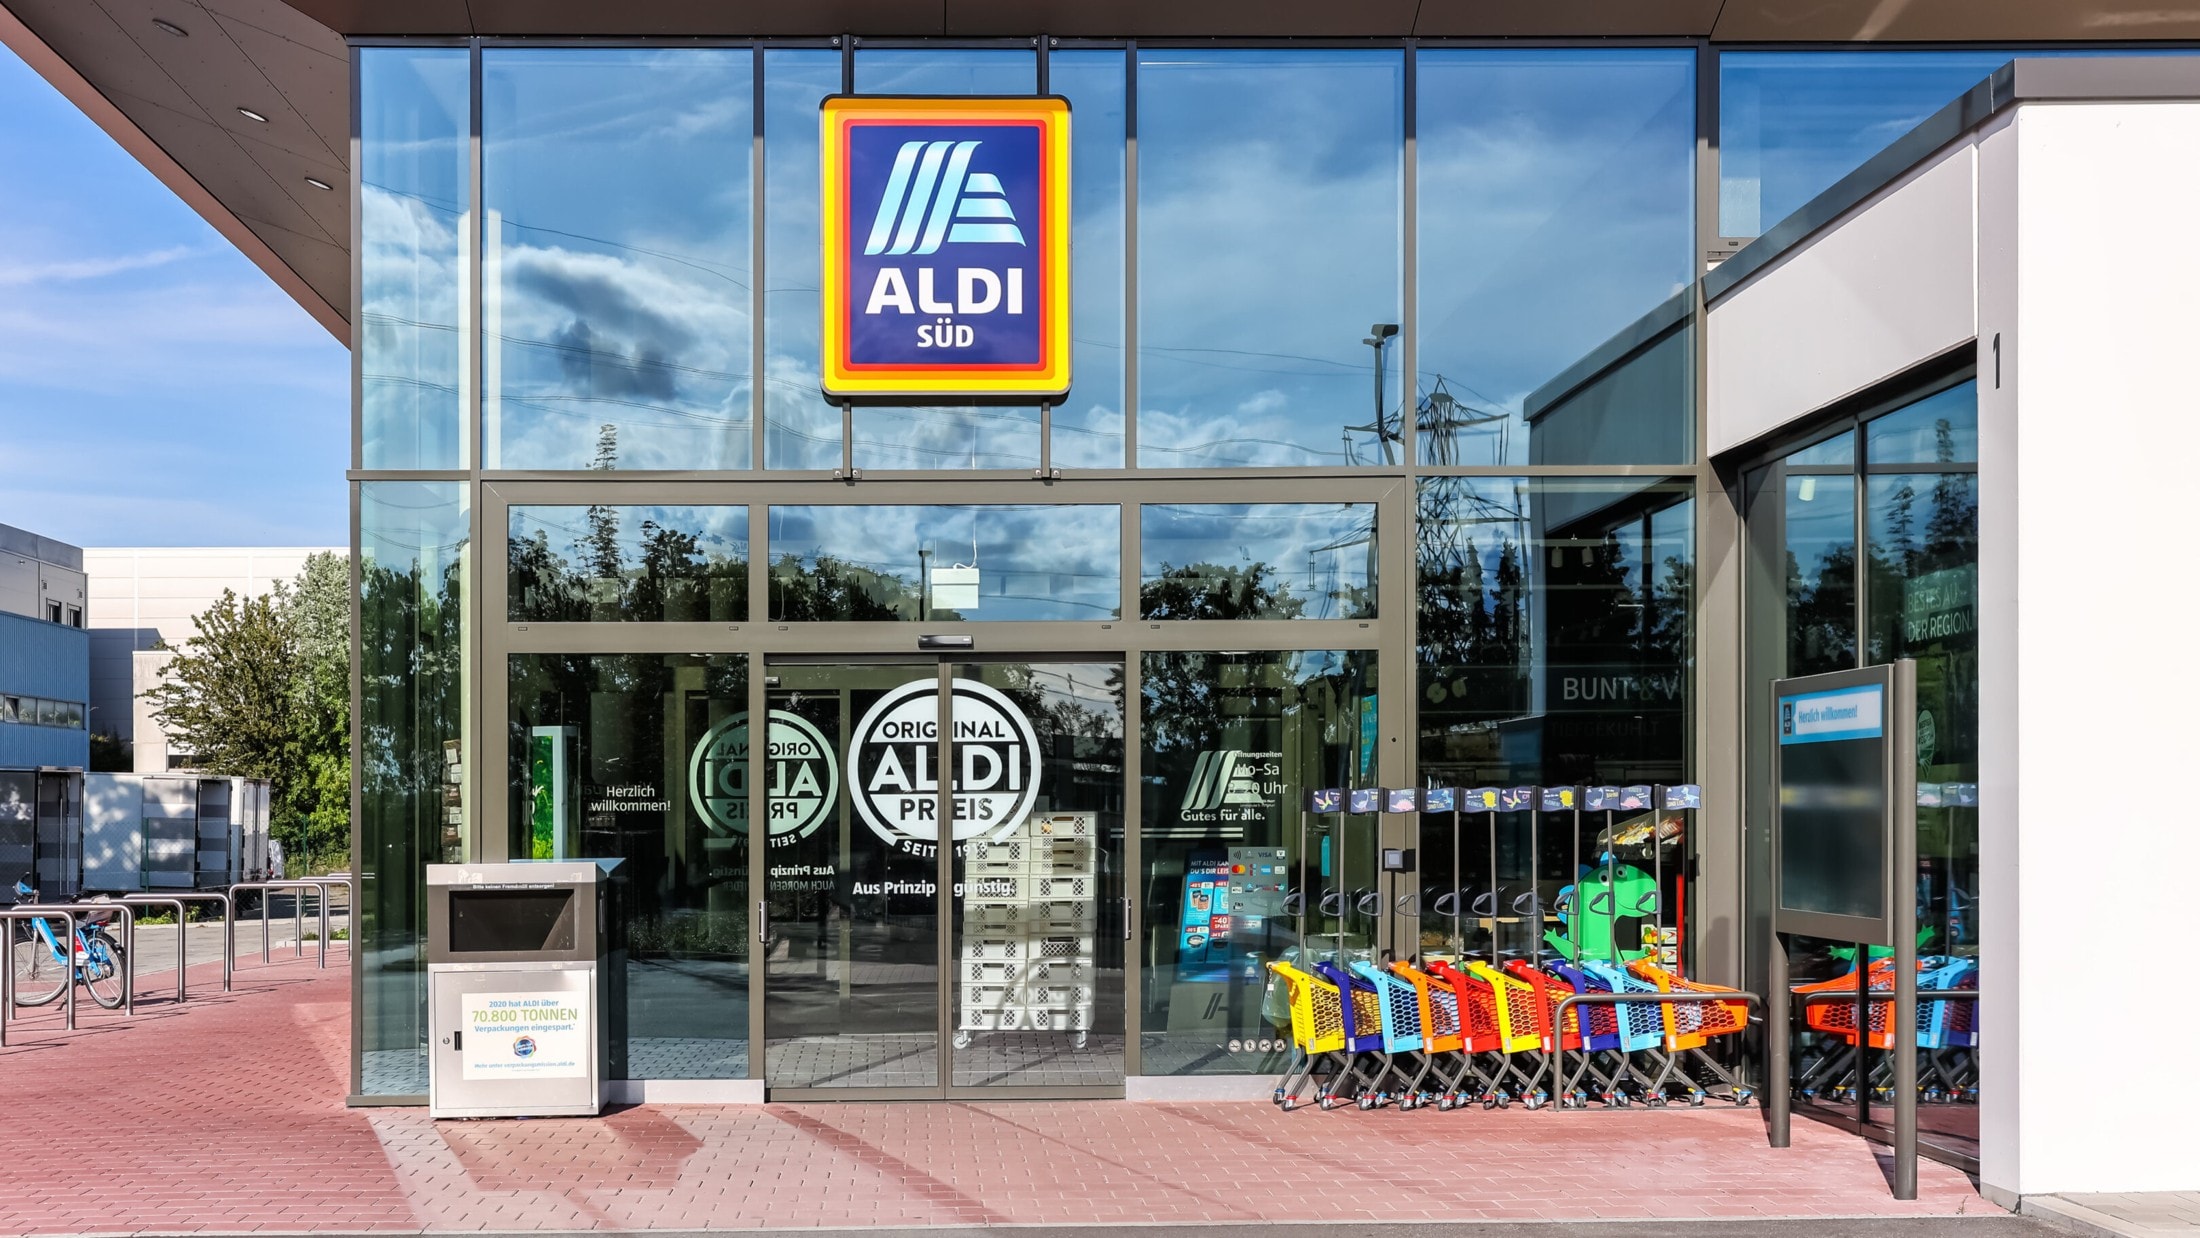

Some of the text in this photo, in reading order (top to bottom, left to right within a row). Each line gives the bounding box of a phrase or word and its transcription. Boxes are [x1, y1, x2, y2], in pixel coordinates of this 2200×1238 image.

[865, 267, 1023, 315] ALDI
[917, 317, 974, 348] SÜD
[1992, 332, 2001, 390] 1
[1908, 586, 1942, 614] BESTES
[1908, 609, 1973, 643] DER REGION.
[1563, 677, 1633, 700] BUNT
[1661, 677, 1684, 700] V
[1798, 708, 1820, 724] Herzlich
[1820, 704, 1858, 720] willkommen!
[882, 720, 1005, 738] ORIGINAL
[868, 744, 1020, 791] ALDI
[606, 785, 655, 798] Herzlich
[1263, 781, 1289, 795] Uhr
[591, 799, 671, 812] willkommen!
[900, 798, 993, 820] PREIS
[1180, 808, 1266, 822] Gutes für alle.
[901, 840, 937, 858] SEIT
[852, 878, 1015, 897] Aus Prinzip günstig.
[489, 1000, 507, 1008] 2020
[523, 999, 539, 1007] ALDI
[541, 999, 559, 1007] über
[472, 1008, 578, 1023] 70.800 TONNEN
[474, 1025, 530, 1033] Verpackungen
